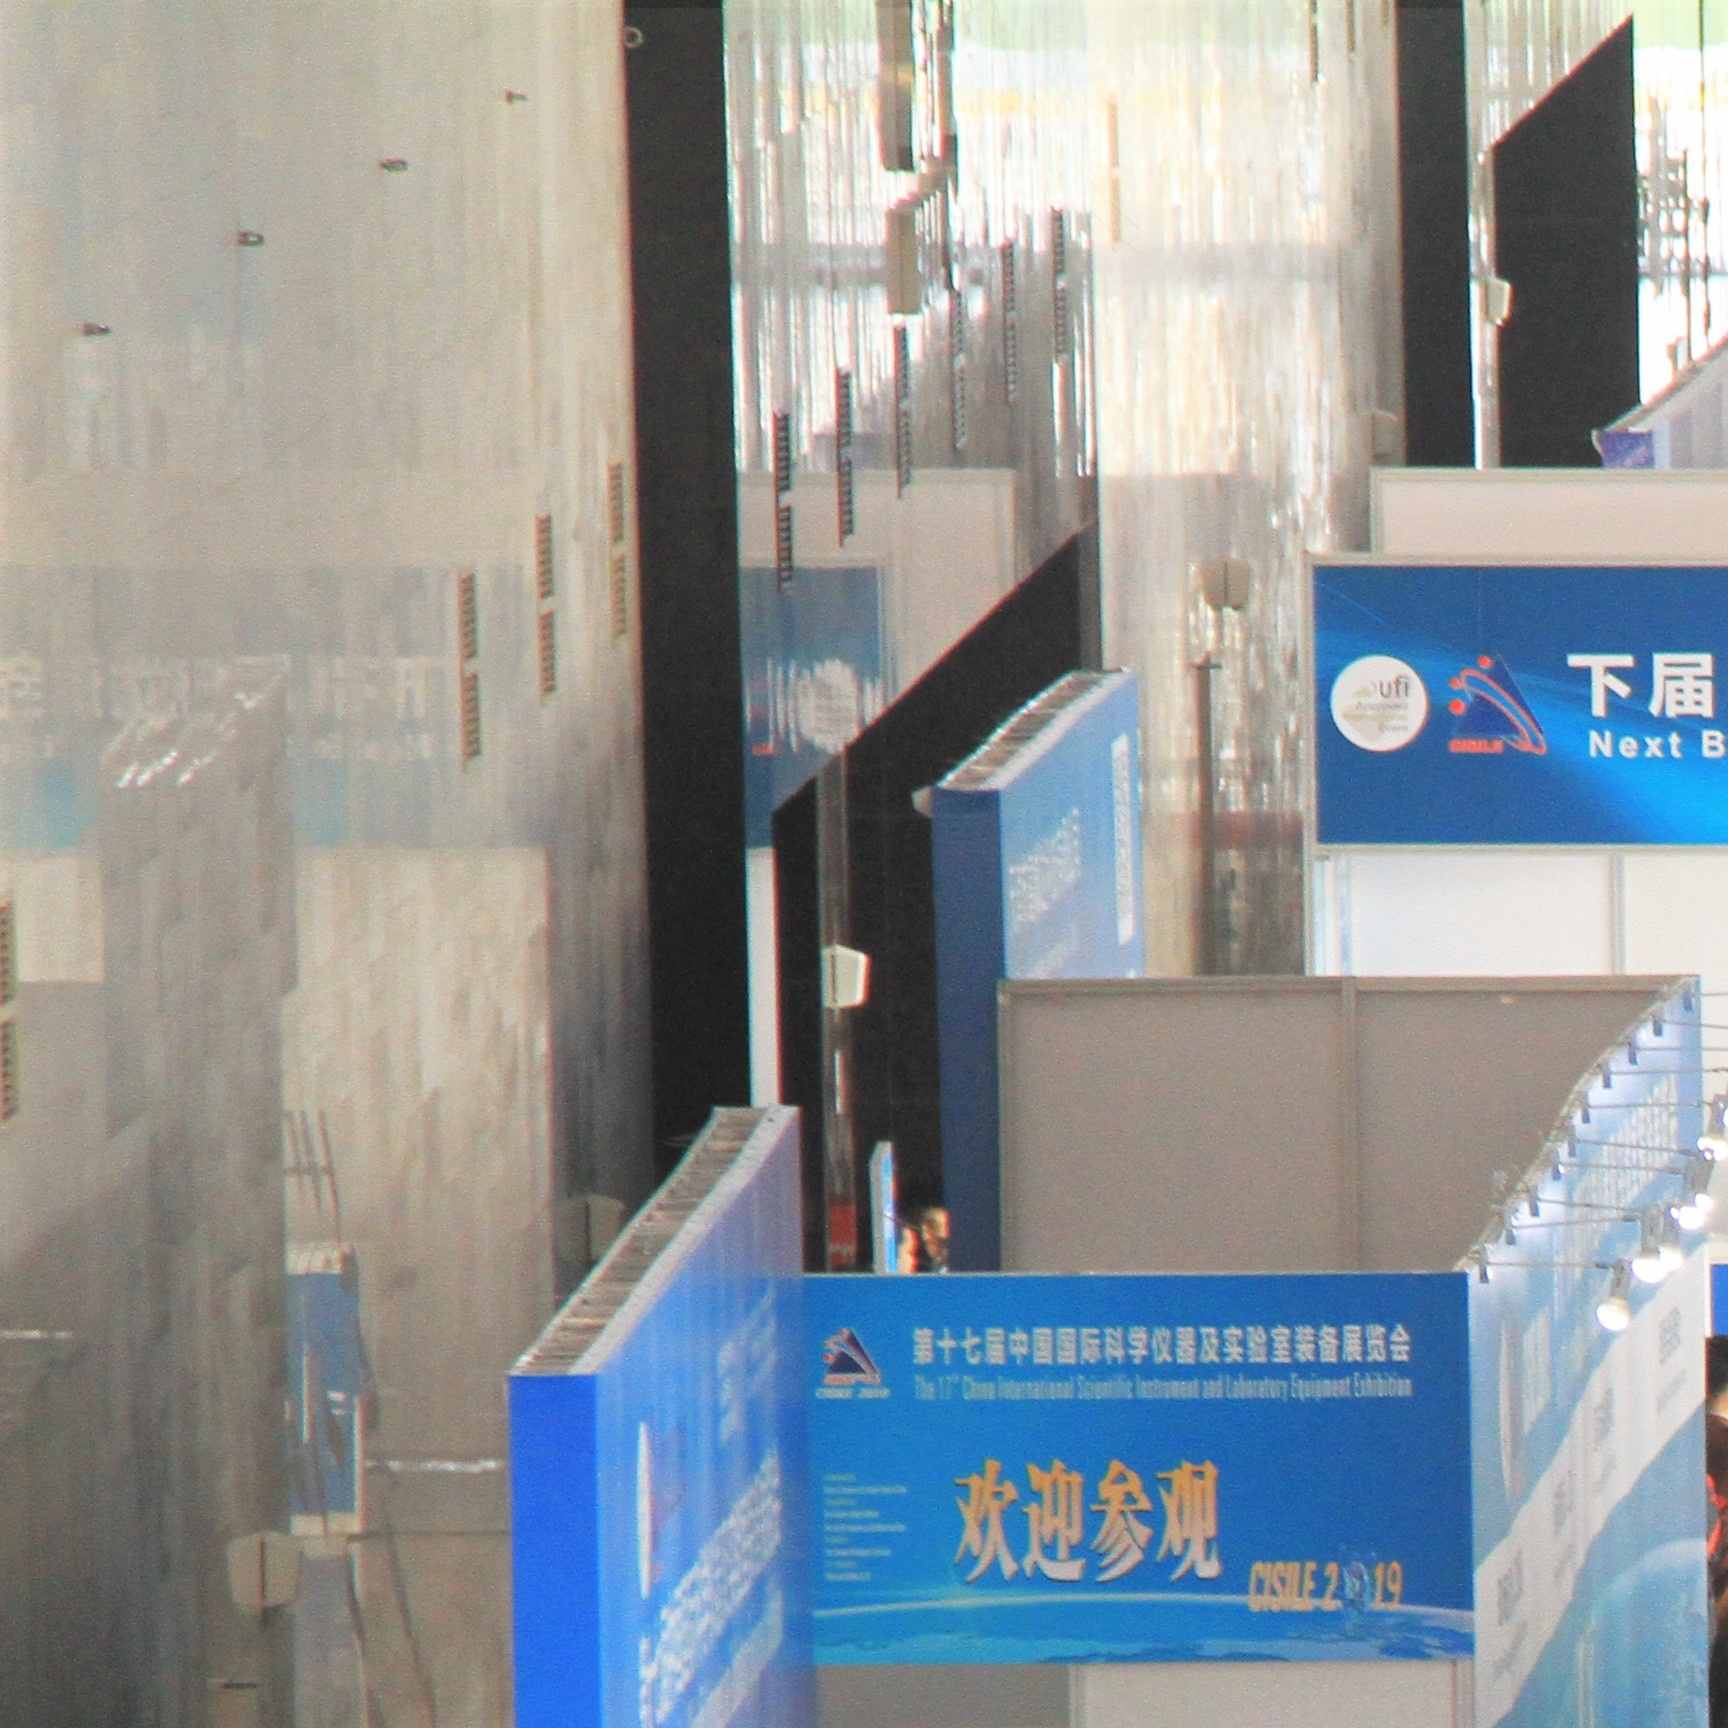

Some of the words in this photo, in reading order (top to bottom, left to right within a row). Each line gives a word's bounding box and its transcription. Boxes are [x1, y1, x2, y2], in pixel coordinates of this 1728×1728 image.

[1588, 731, 1682, 759] Next
[913, 1324, 1411, 1365] 第十七届中国国际科学仪器及实验室装备展览会
[954, 1458, 1222, 1584] 欢迎参观
[1247, 1561, 1317, 1612] CISILE
